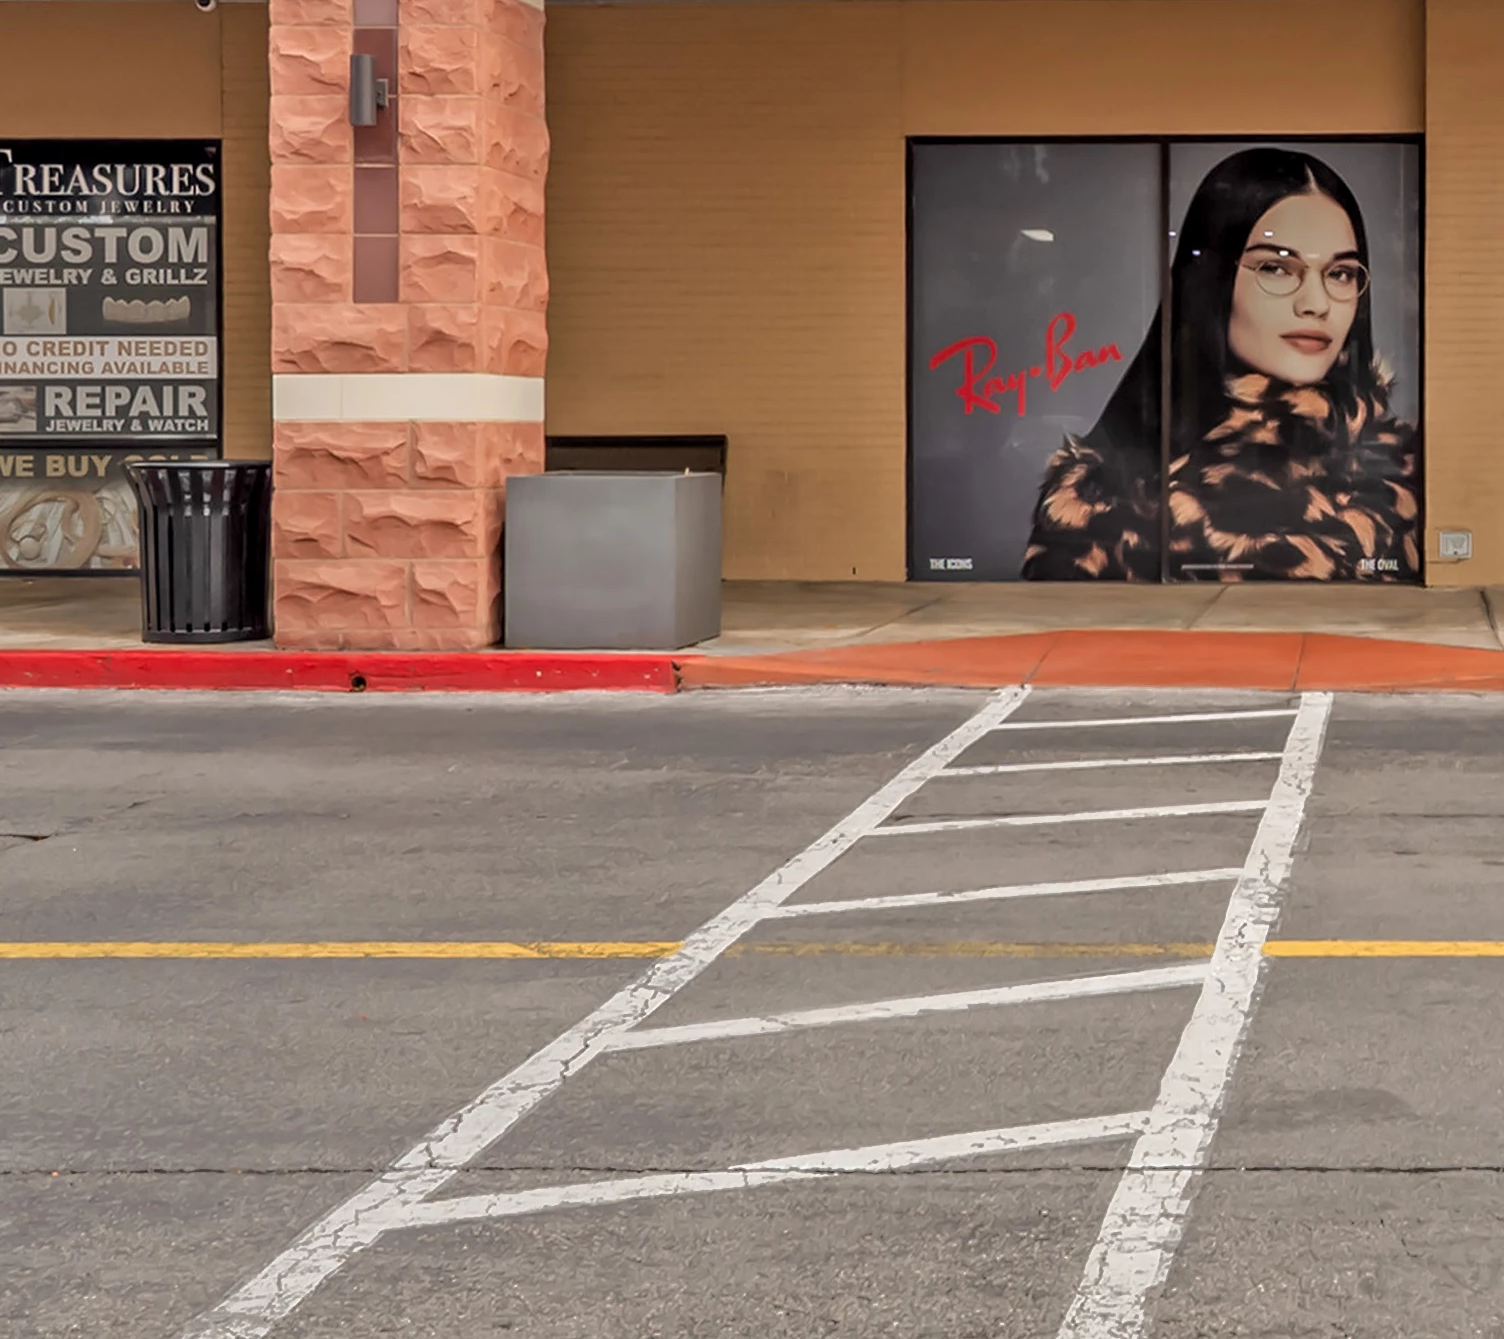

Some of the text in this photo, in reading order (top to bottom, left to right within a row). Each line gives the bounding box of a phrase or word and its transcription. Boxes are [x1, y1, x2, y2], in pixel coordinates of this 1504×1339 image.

[2, 200, 195, 214] CUSTOM JEWELRY
[101, 268, 117, 285] &
[125, 268, 208, 285] GRILLZ
[26, 340, 109, 357] CREDIT
[118, 340, 208, 357] NEEDED
[101, 361, 208, 375] AVAILABLE
[45, 385, 208, 417] REPAIR
[46, 419, 209, 432] JEWELRY & WATCH
[47, 455, 112, 477] BUY
